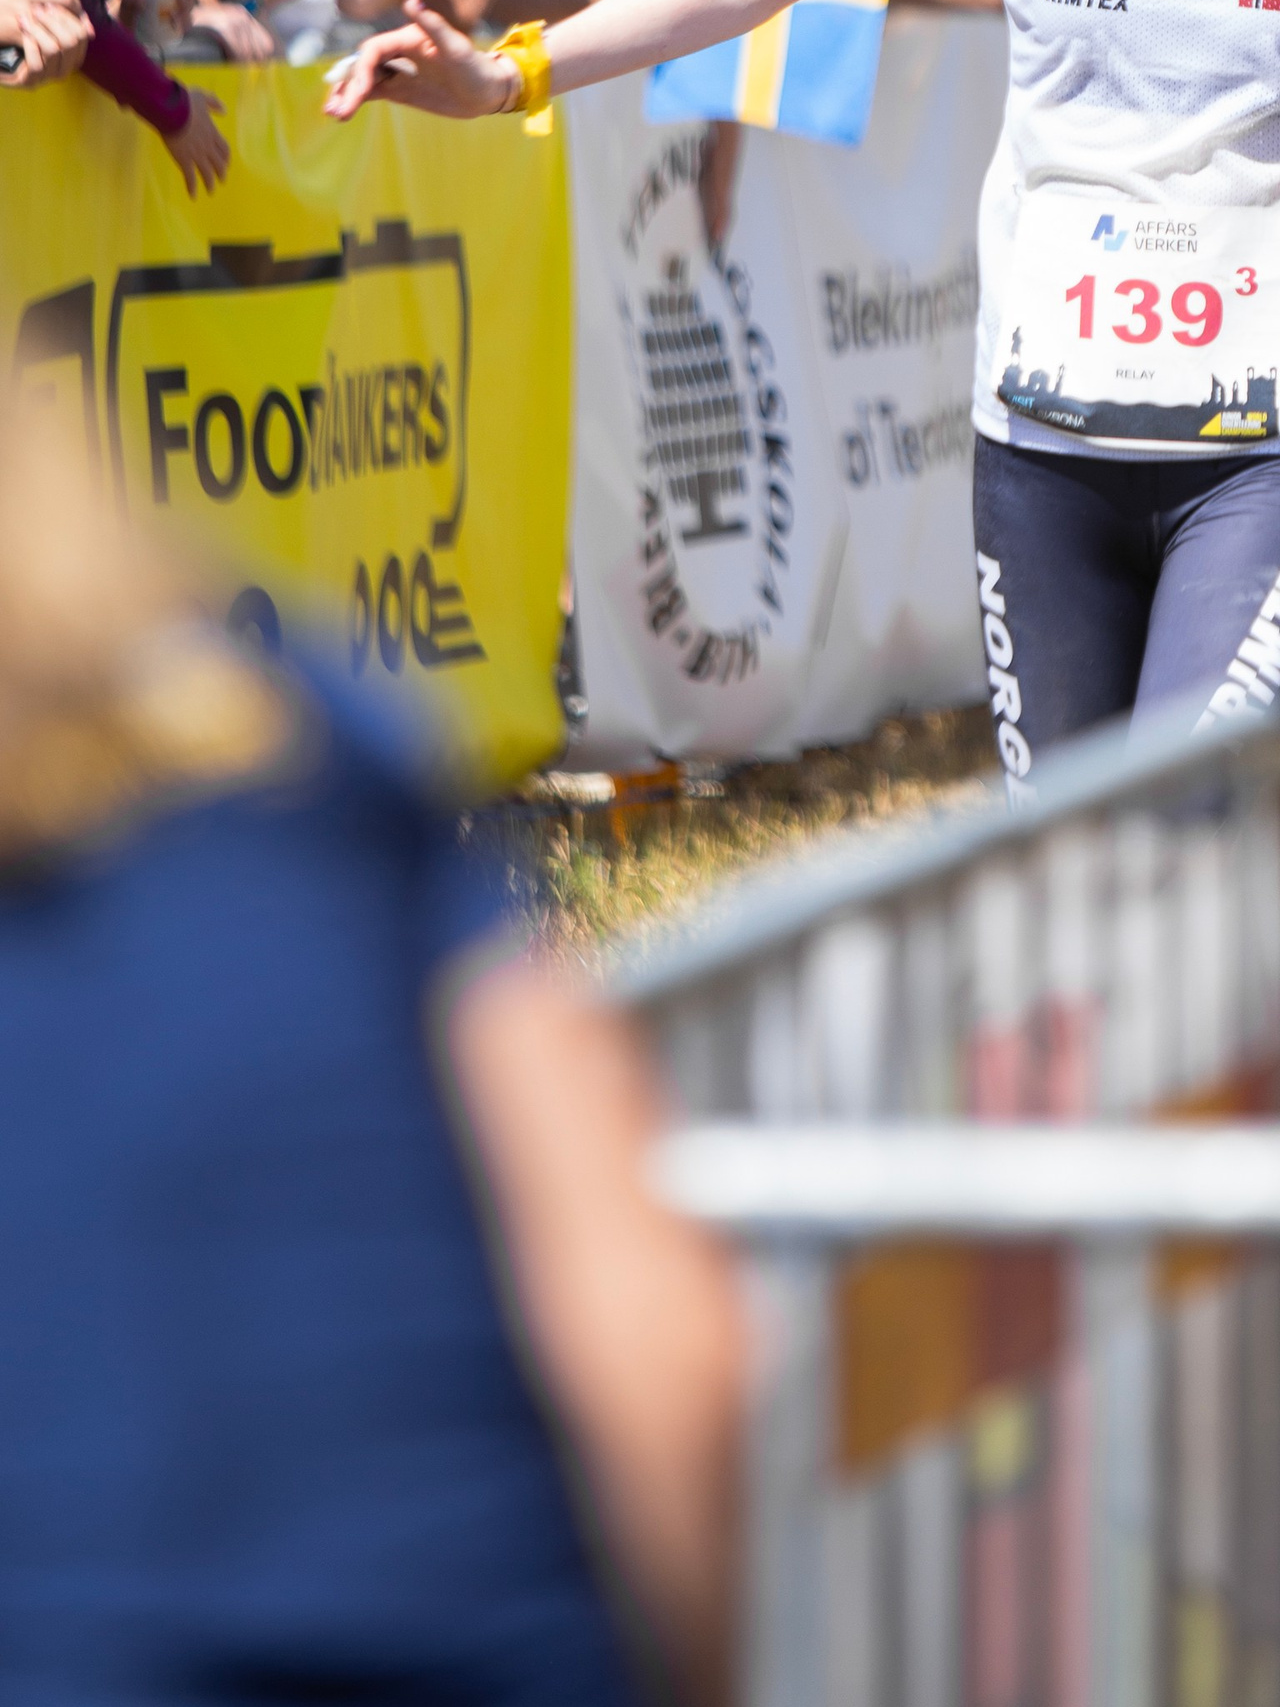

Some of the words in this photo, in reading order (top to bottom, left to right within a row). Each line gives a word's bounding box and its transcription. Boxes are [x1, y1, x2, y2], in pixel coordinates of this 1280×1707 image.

[1135, 219, 1197, 237] AFFÄRS
[1135, 237, 1198, 253] VERKEN
[1066, 274, 1223, 347] 139
[1235, 267, 1258, 296] 3
[1115, 368, 1155, 381] RELAY
